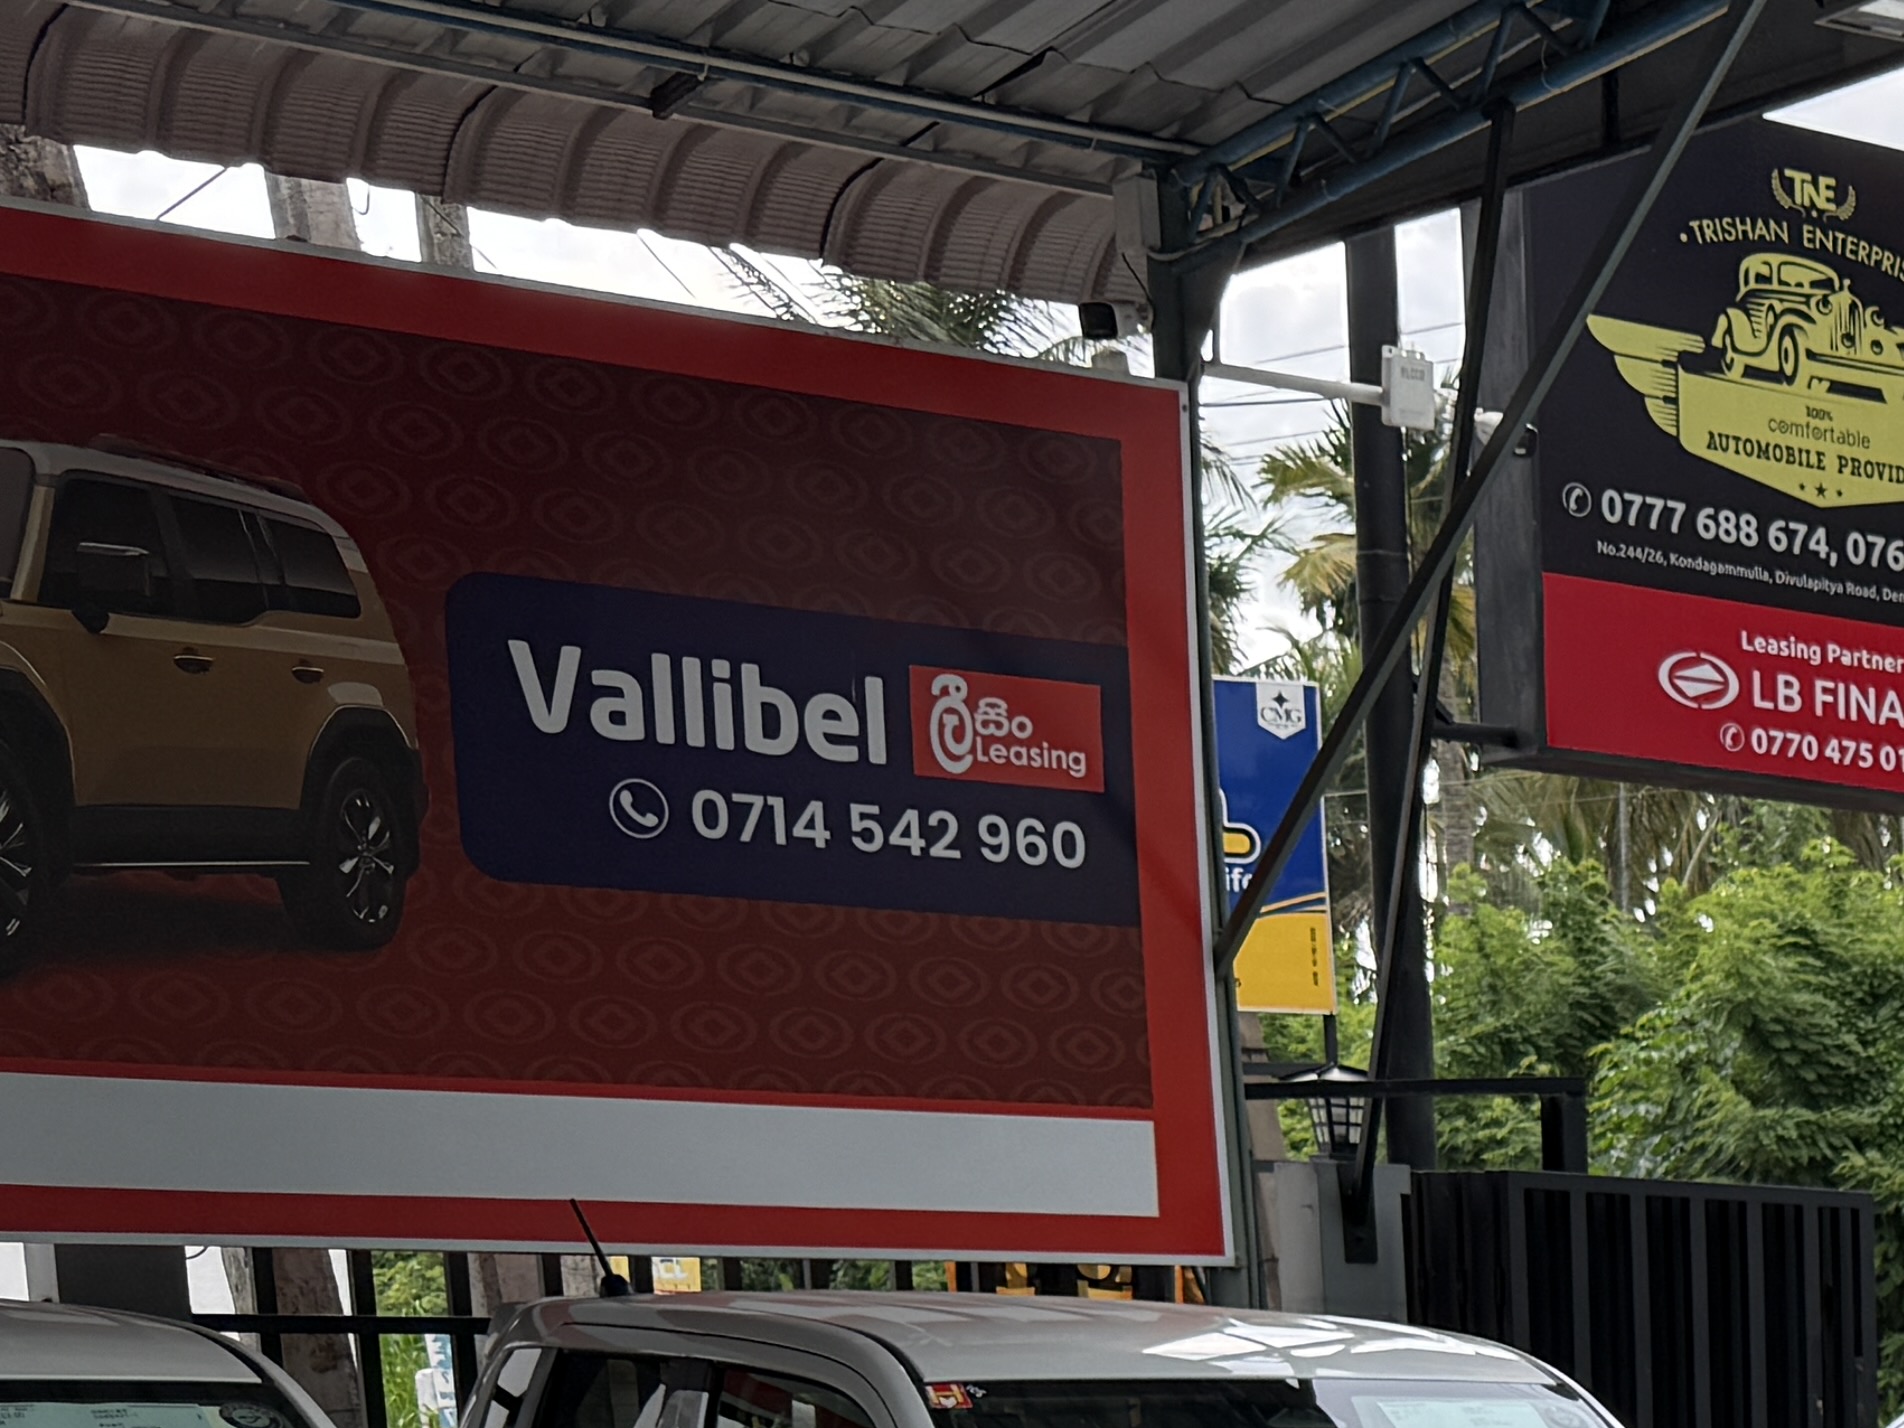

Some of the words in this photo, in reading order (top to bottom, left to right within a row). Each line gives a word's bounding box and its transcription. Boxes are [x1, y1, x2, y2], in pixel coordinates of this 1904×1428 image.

[1689, 217, 1790, 245] TRISHAN
[1768, 418, 1871, 449] comfortable
[1805, 406, 1834, 421] 100%
[1706, 430, 1826, 471] AUTOMOBILE
[1601, 489, 1687, 534] 0777
[1696, 507, 1759, 547] 688
[1767, 519, 1838, 567] 674,
[1846, 580, 1880, 601] Road,
[1740, 630, 1822, 666] Leasing
[507, 639, 888, 765] Vallibel
[1752, 670, 1803, 713] LB
[975, 736, 1087, 779] Leasing
[1751, 727, 1819, 762] 0770
[1824, 738, 1874, 770] 475
[691, 789, 831, 849] 0714
[849, 803, 962, 860] 542
[978, 814, 1086, 869] 960
